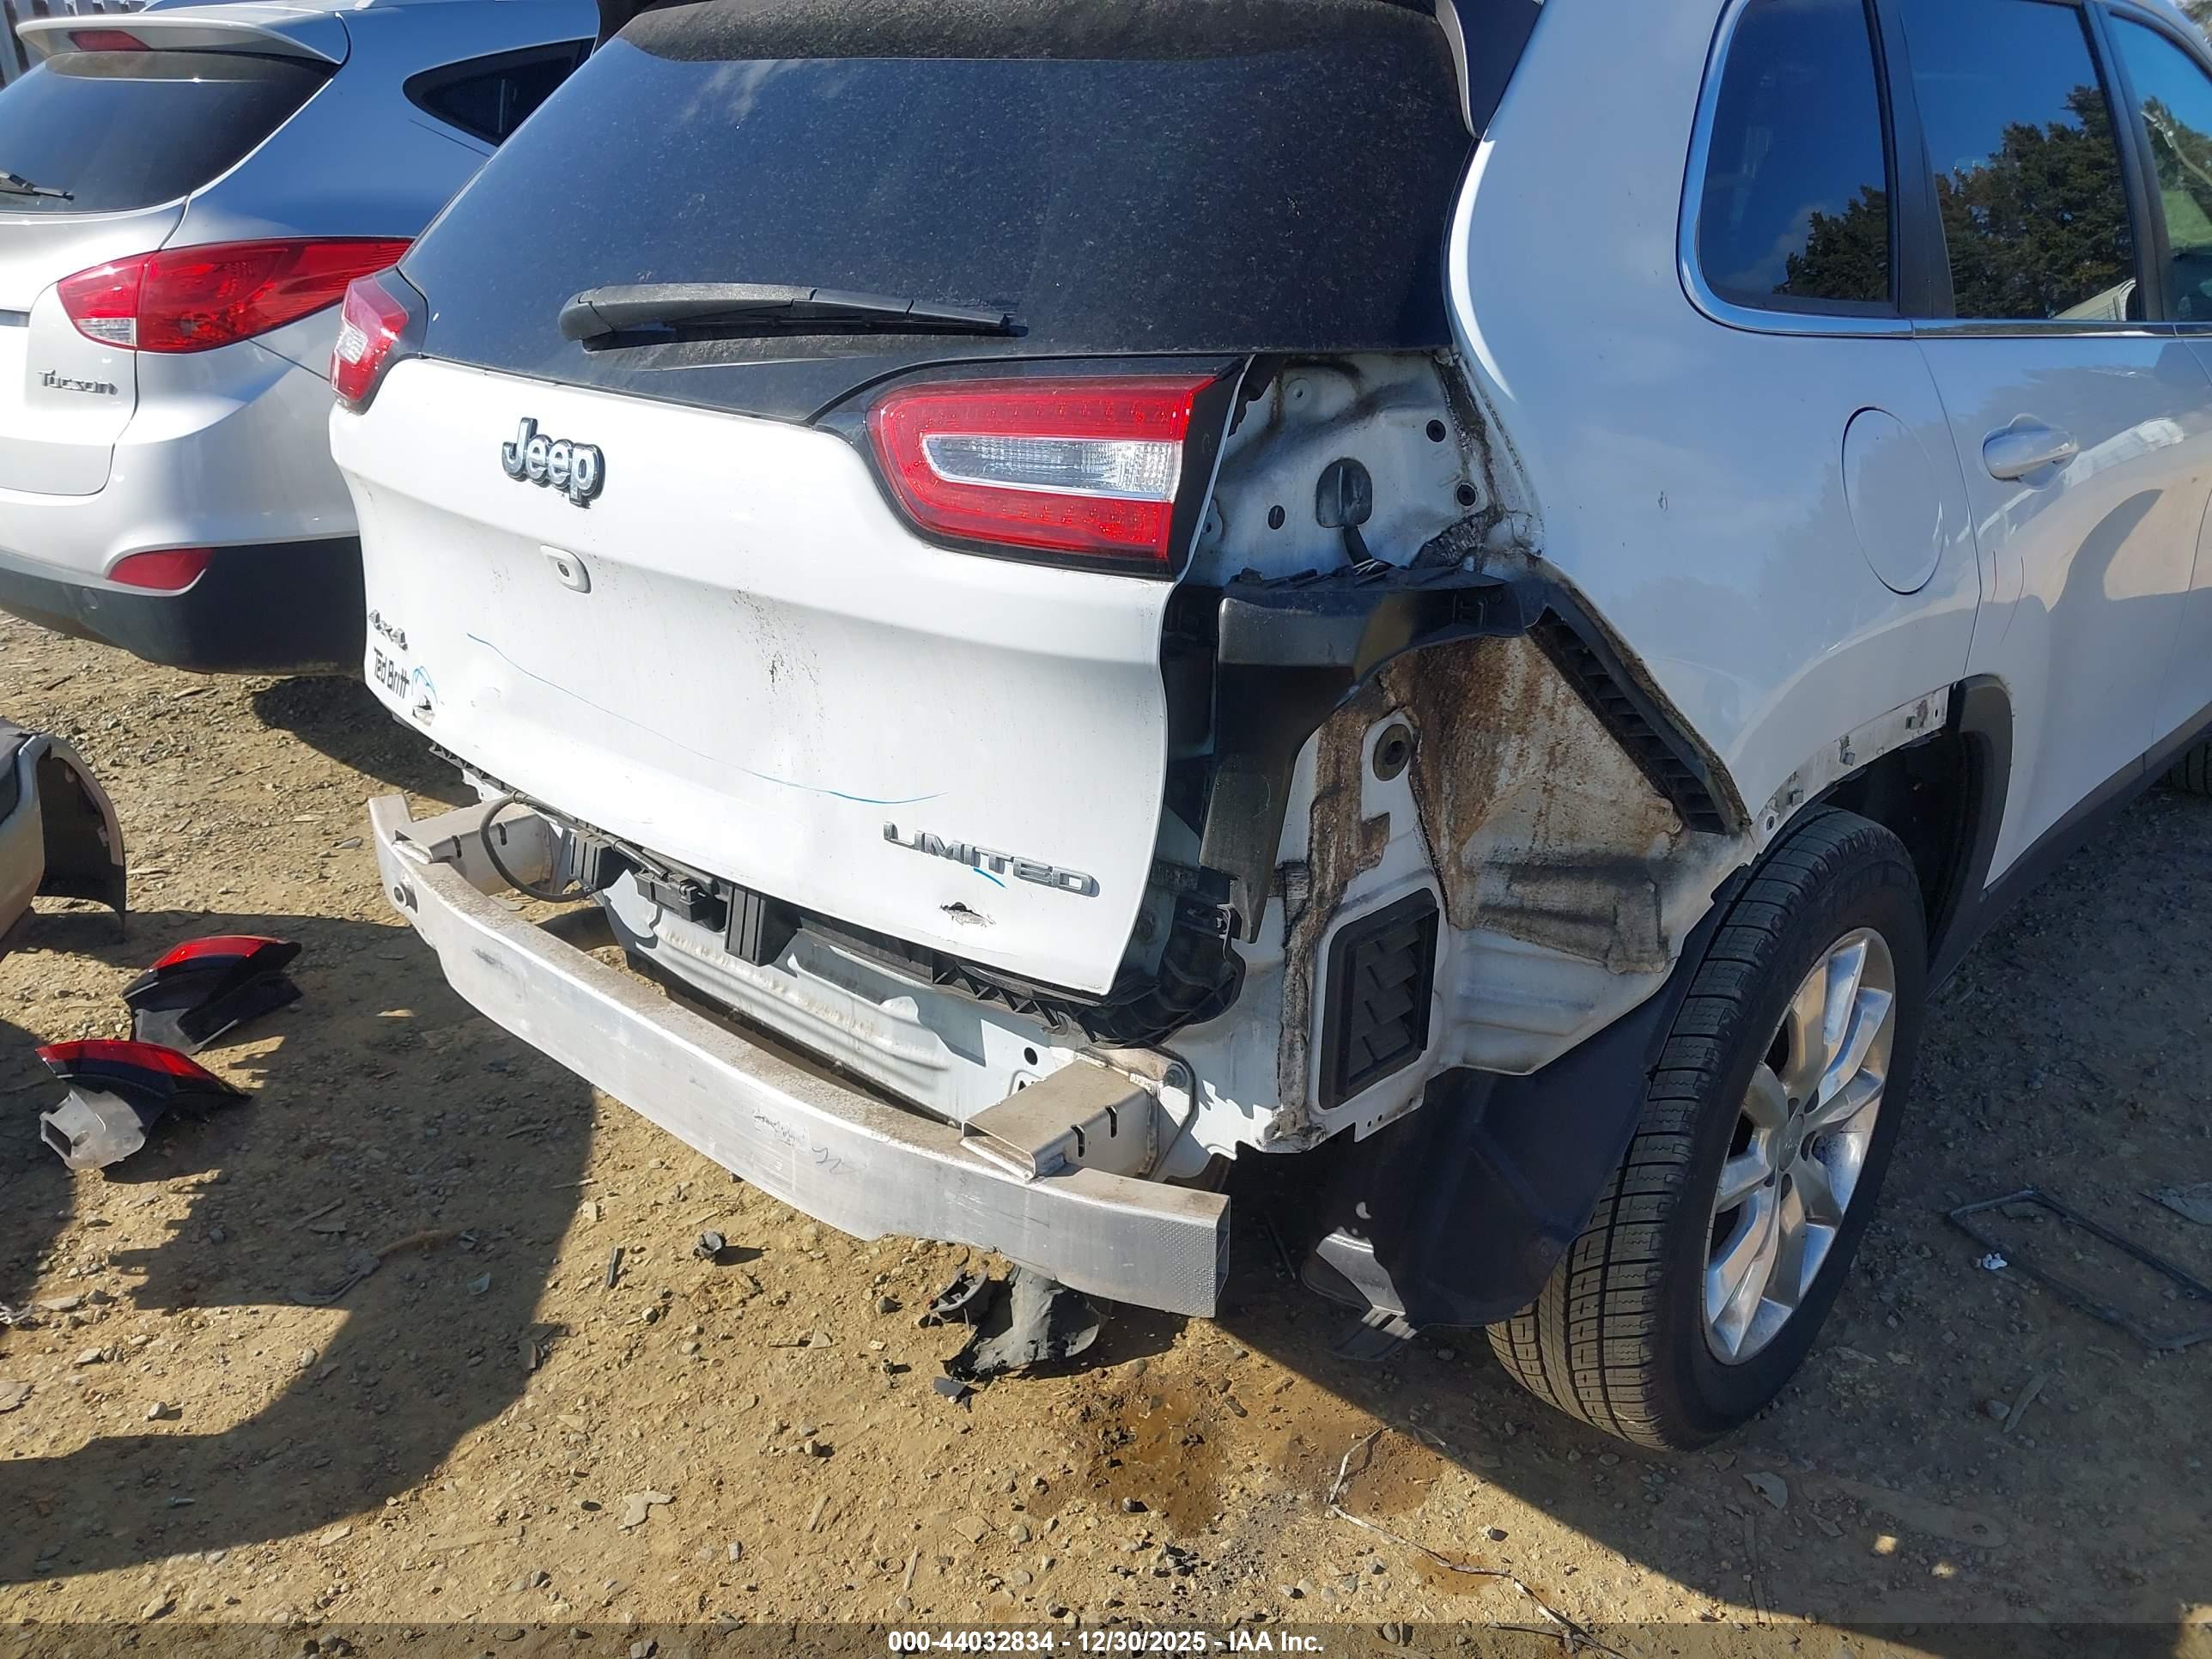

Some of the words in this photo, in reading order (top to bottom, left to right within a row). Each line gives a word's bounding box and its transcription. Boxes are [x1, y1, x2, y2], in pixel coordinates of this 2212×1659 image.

[37, 369, 118, 395] Tucson
[501, 416, 605, 509] Jeep
[374, 645, 387, 685] Ted
[386, 659, 410, 700] Britt
[883, 821, 1101, 898] LIMITED
